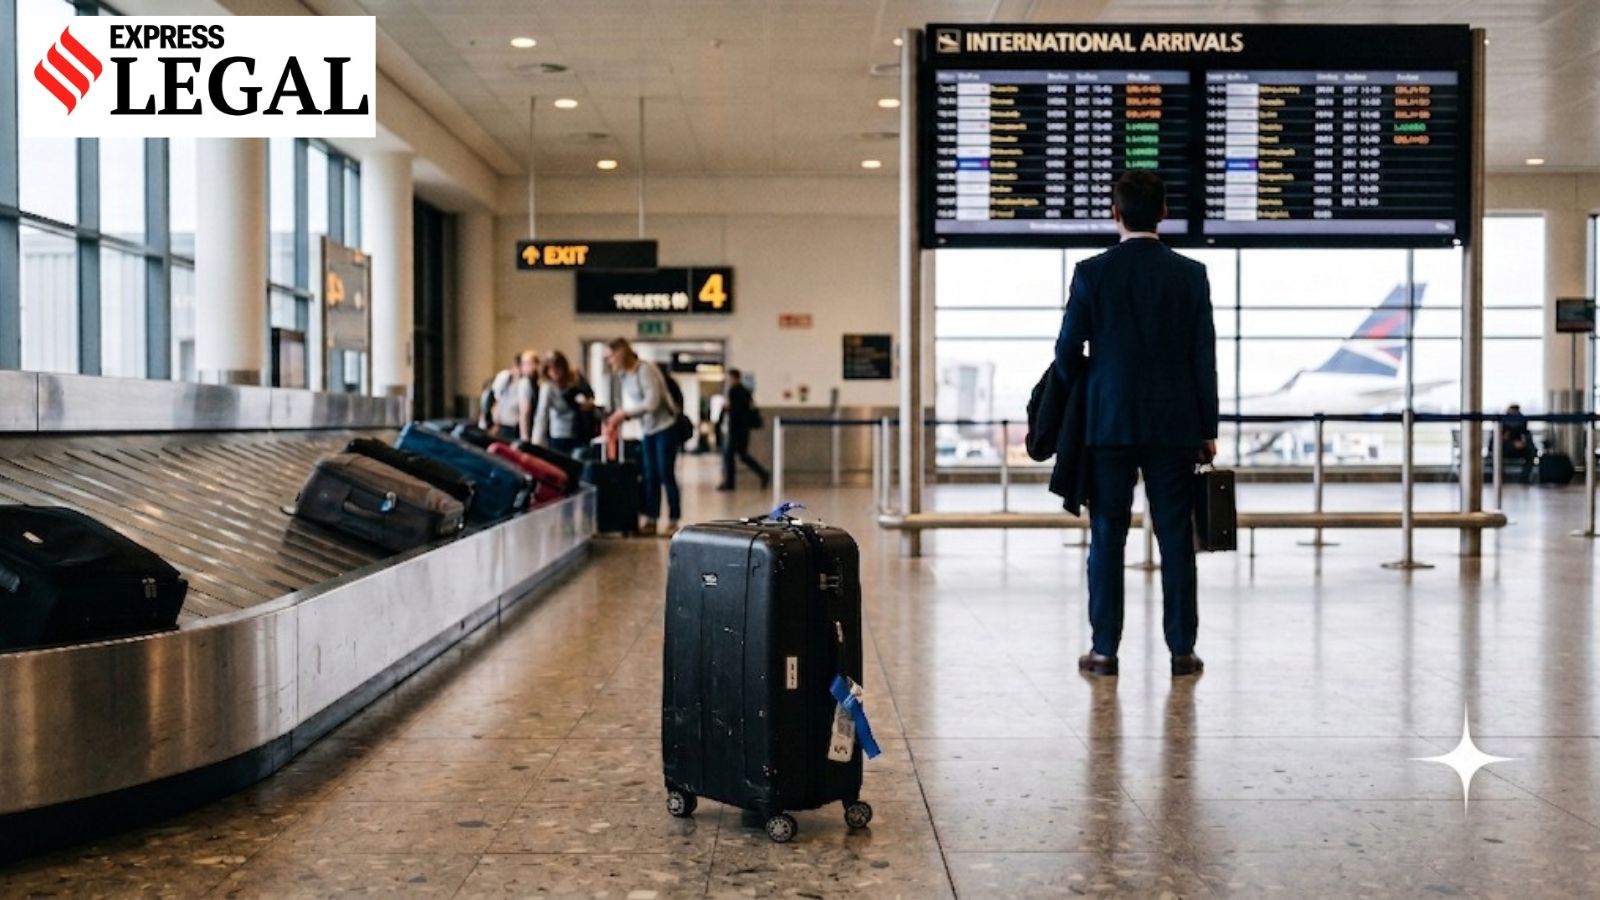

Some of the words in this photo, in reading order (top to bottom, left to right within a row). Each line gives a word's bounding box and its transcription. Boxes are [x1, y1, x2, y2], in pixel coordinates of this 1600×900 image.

[966, 32, 1136, 52] INTERNATIONAL
[1140, 32, 1244, 52] ARRIVALS
[544, 245, 589, 265] EXIT
[698, 273, 727, 308] 4
[613, 293, 671, 310] TOILETS
